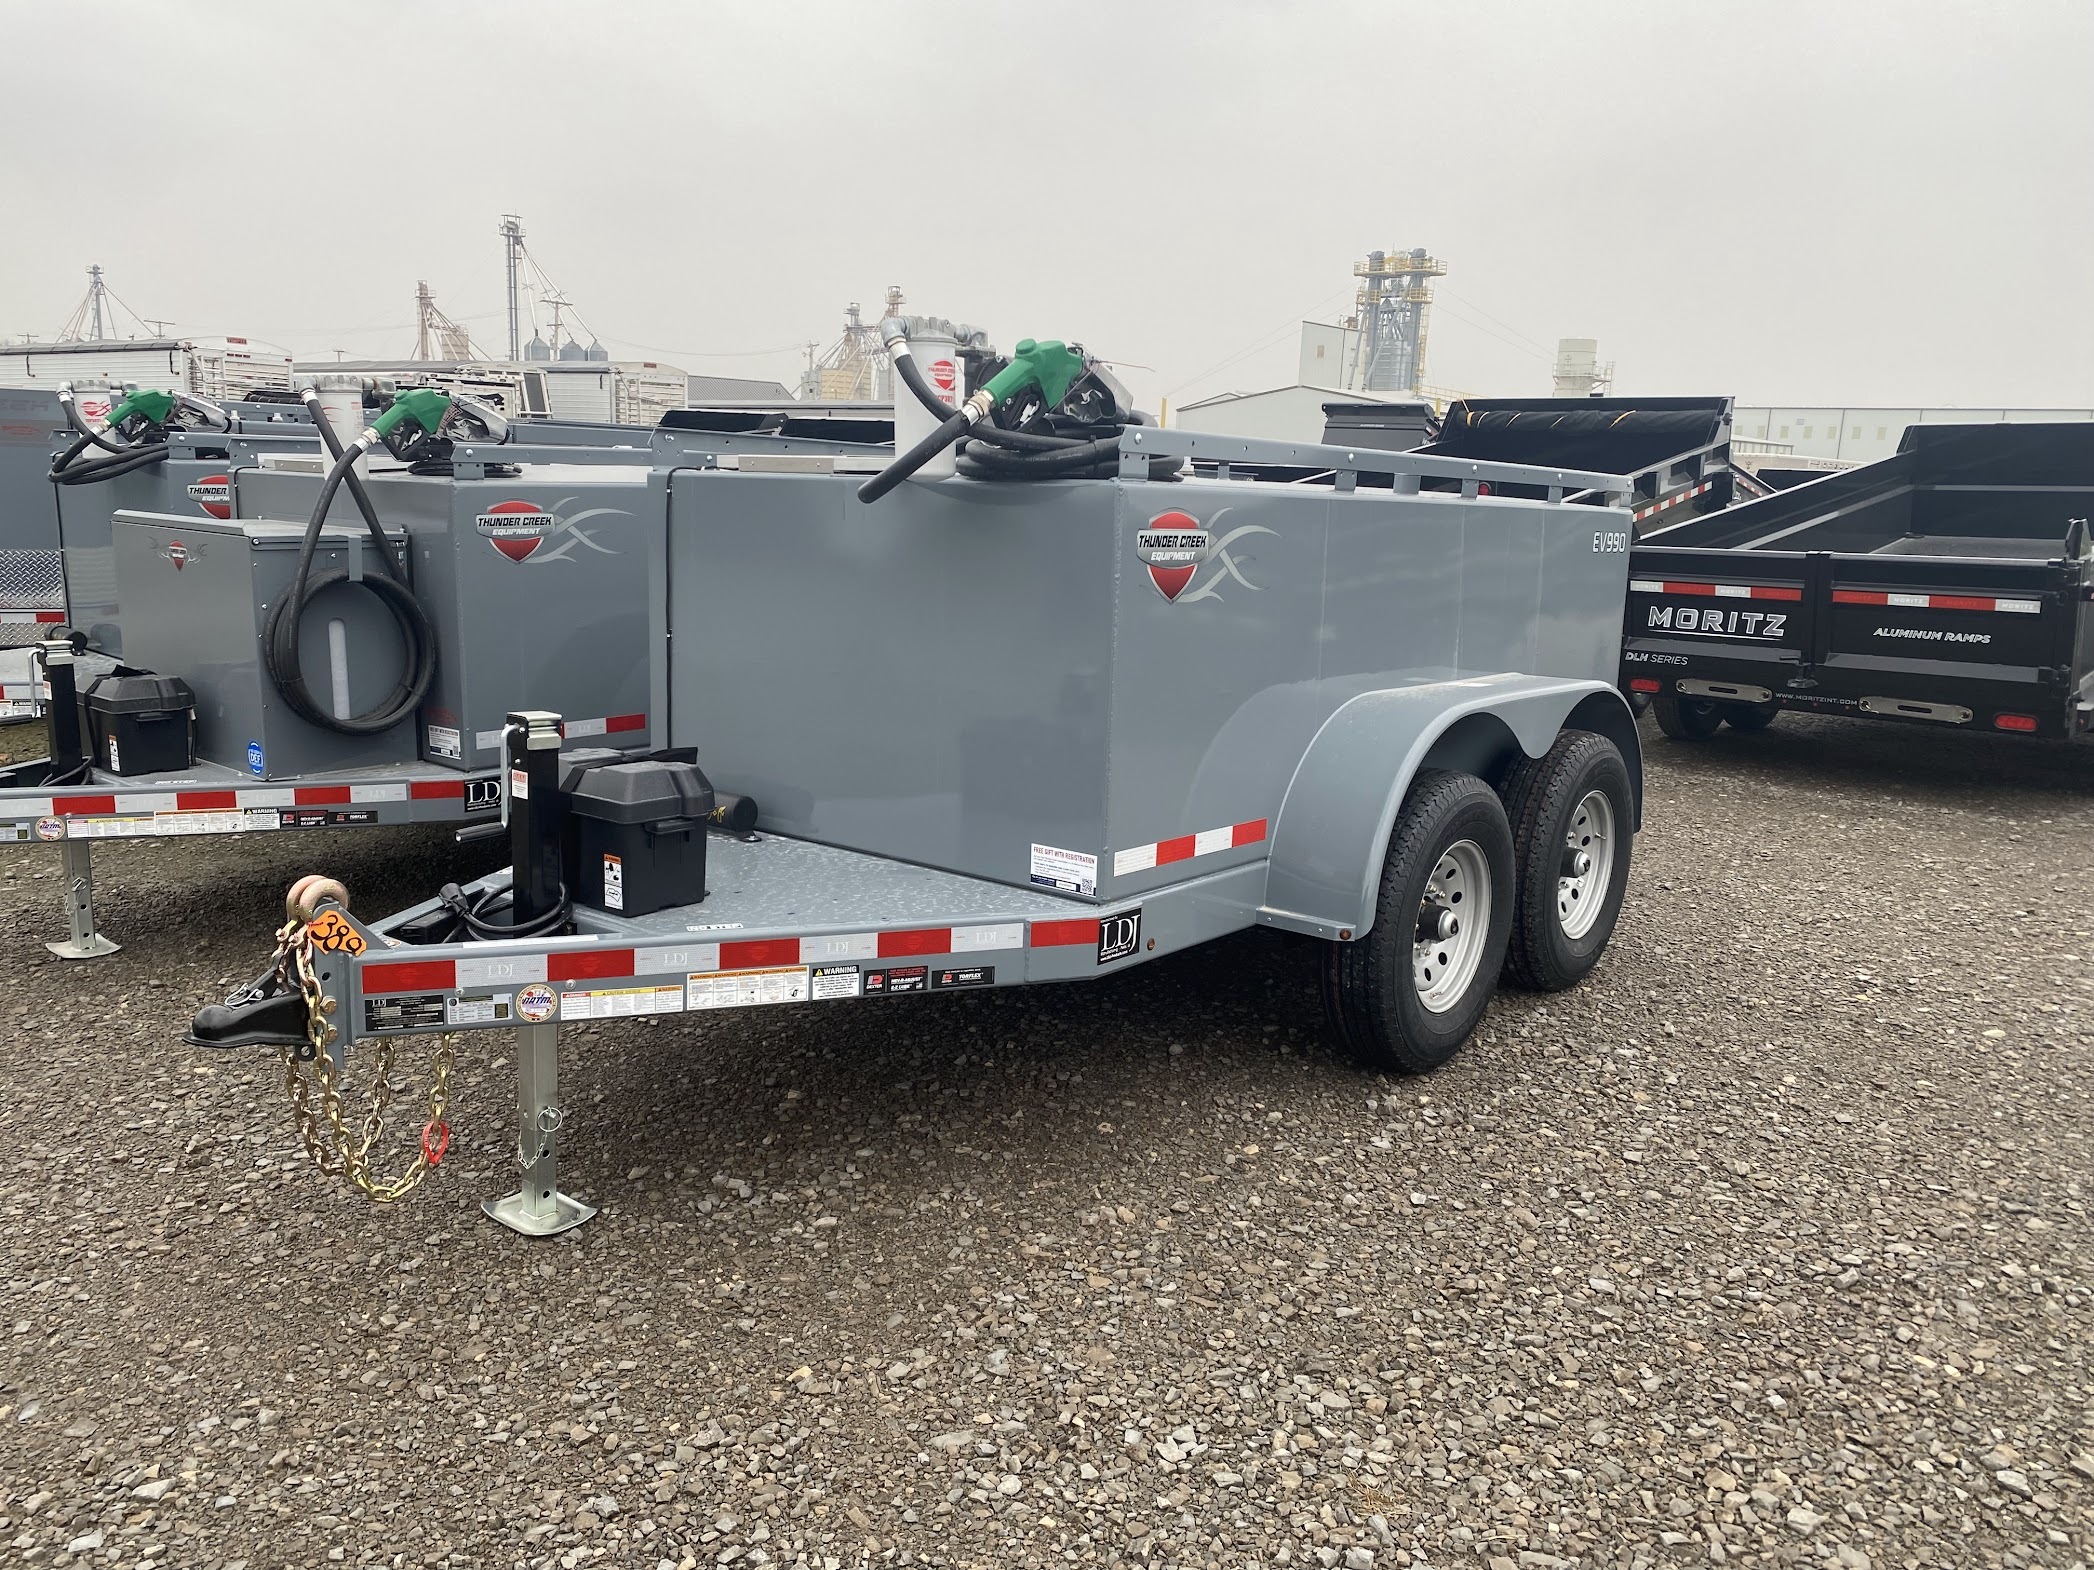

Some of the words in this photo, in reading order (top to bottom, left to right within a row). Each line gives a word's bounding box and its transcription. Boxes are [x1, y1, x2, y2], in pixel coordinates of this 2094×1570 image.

[189, 487, 228, 495] THUNDER
[478, 518, 521, 527] THUNDER
[522, 516, 552, 526] CREEK
[492, 528, 541, 536] EQUIPMENT
[1139, 535, 1179, 548] THUNDER
[1179, 535, 1207, 548] CREEK
[1592, 531, 1626, 553] EV990
[1151, 551, 1196, 561] EQUIPMENT
[2001, 602, 2034, 610] MORITZ
[1648, 606, 1787, 636] MORITZ
[1873, 627, 1942, 641] ALUMINUM
[1944, 632, 1991, 644] RAMPS
[1625, 652, 1649, 662] DLH
[1650, 654, 1689, 666] SERIES
[1775, 692, 1858, 706] WWW.MORITZINT.COM
[1033, 846, 1044, 854] FREE
[1055, 850, 1065, 858] WITH
[1065, 852, 1095, 864] REGISTRATION
[976, 931, 997, 943] LDJ
[1101, 914, 1141, 952] LDJ
[827, 941, 849, 953] LDJ
[664, 952, 688, 964] LDJ
[488, 963, 514, 977] LDJ
[823, 966, 857, 975] WARNING
